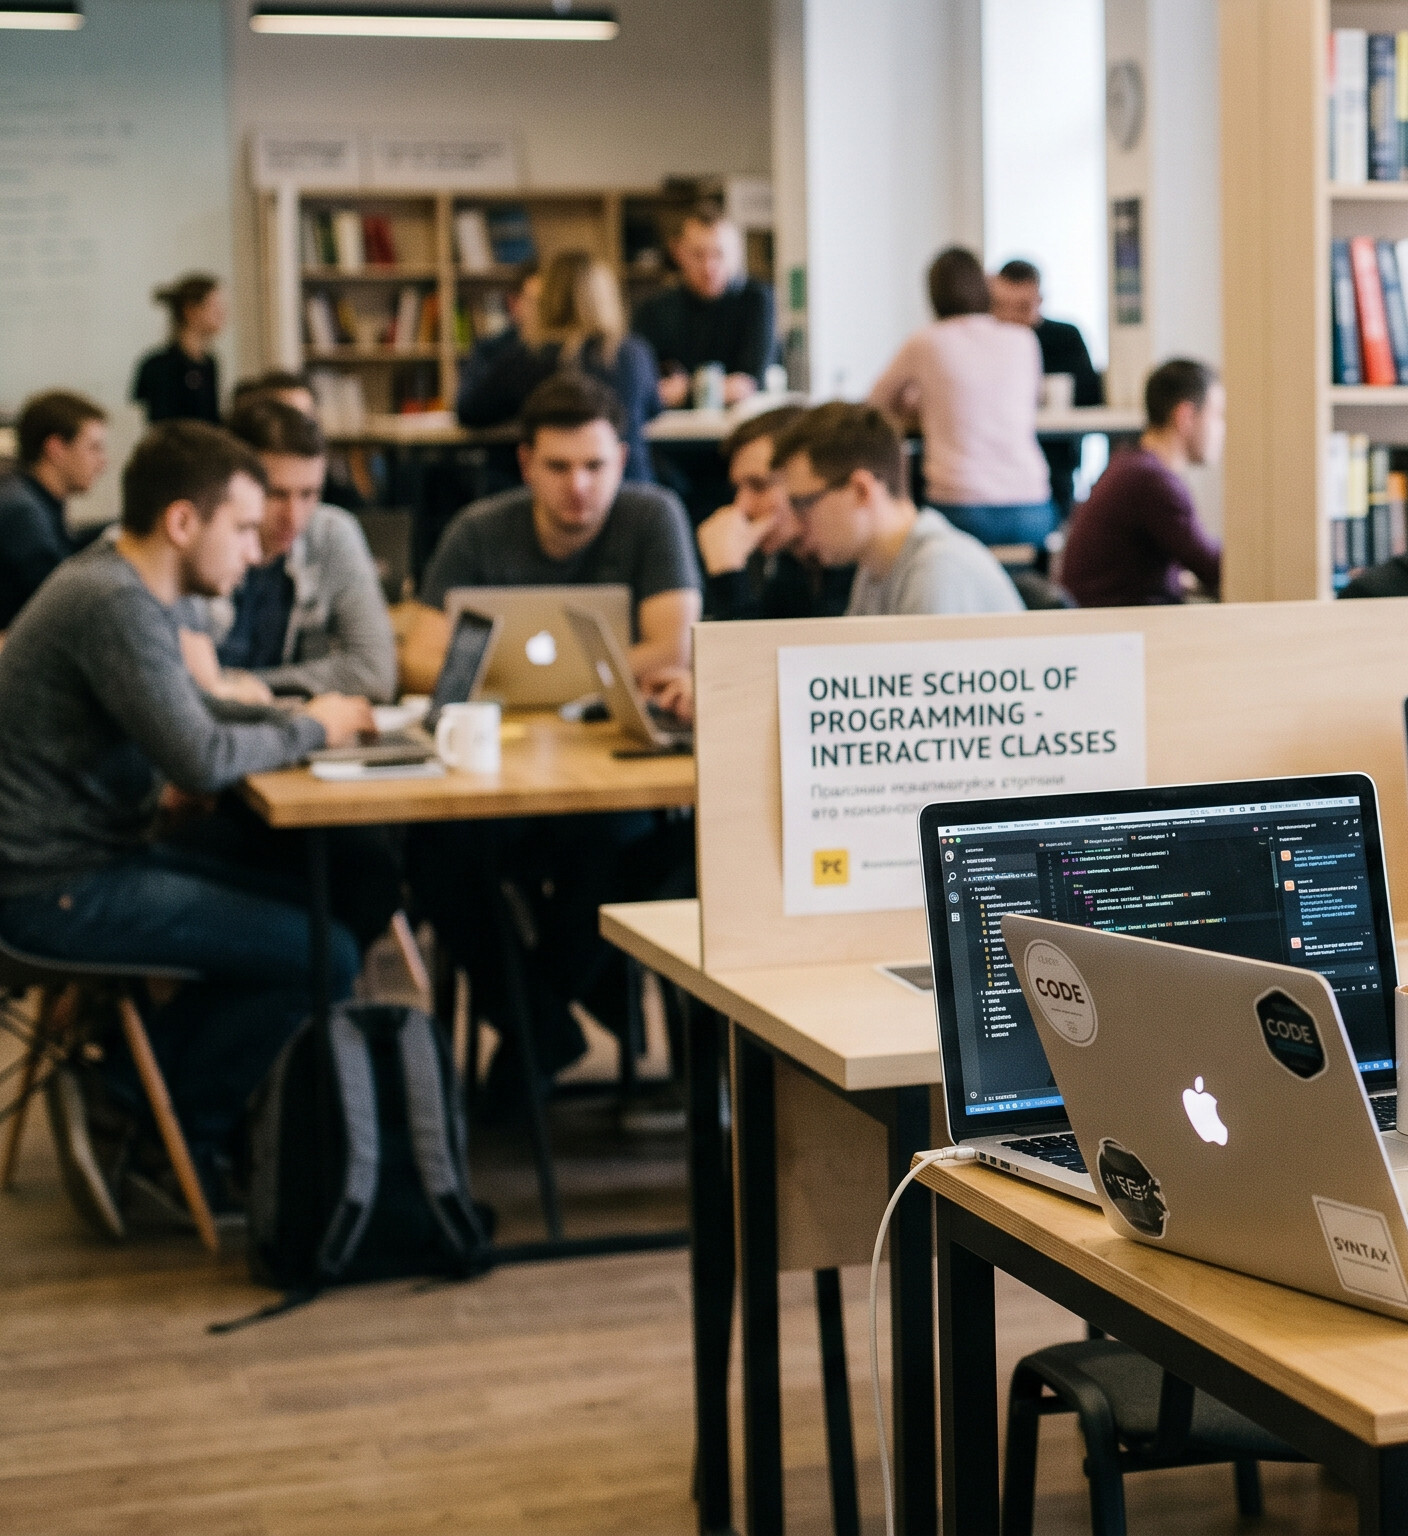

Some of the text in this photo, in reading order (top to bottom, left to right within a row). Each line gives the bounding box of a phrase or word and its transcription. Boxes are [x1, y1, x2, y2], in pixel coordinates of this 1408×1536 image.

[809, 667, 1078, 700] ONLINE SCHOOL OF
[811, 703, 1025, 734] PROGRAMMING
[811, 730, 1117, 767] INTERACTIVE CLASSES
[1035, 977, 1085, 1004] CODE
[1266, 1018, 1313, 1044] CODE
[1333, 1236, 1390, 1265] SYNTAX
